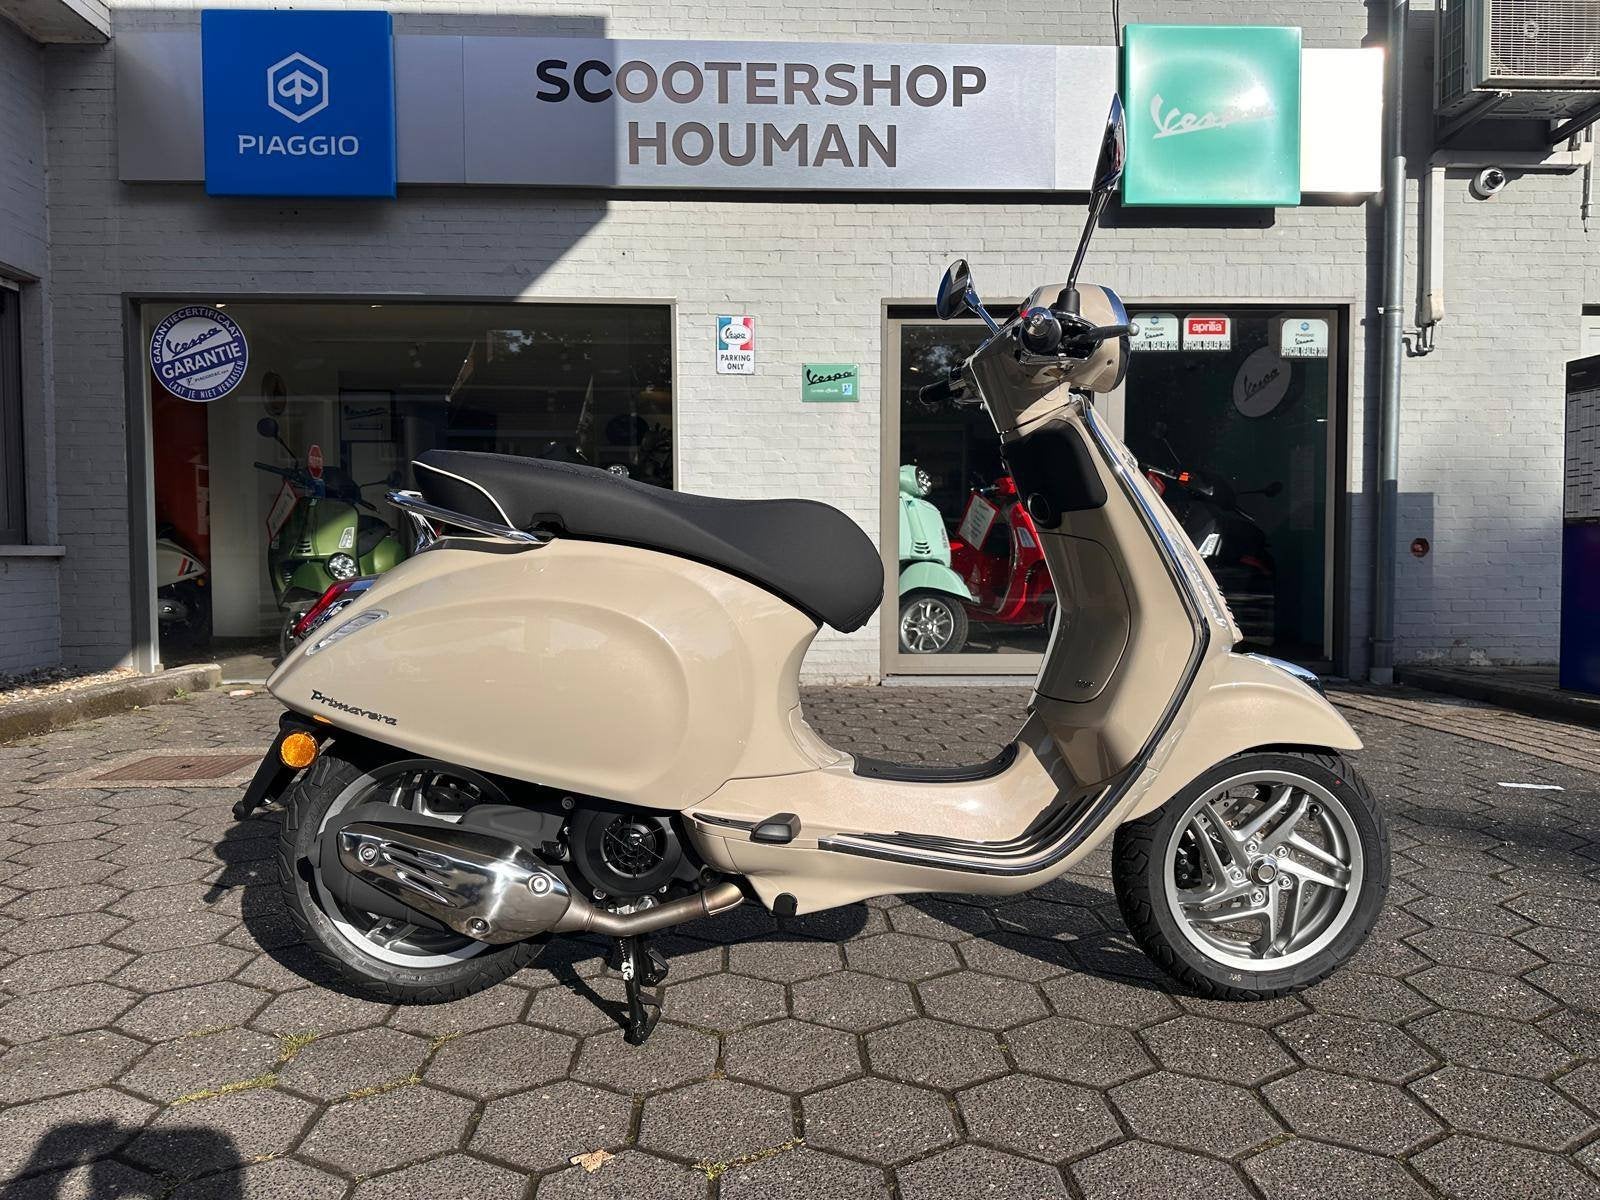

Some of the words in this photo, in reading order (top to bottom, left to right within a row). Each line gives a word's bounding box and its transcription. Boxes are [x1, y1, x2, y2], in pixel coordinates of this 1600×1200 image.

[535, 59, 987, 108] SCOOTERSHOP
[237, 134, 360, 156] PIAGGIO
[627, 121, 898, 168] HOUMAN
[152, 307, 241, 364] GARANTIECERTIFICAAT
[165, 327, 223, 358] Vespa
[725, 327, 747, 340] Vespa
[1192, 321, 1222, 334] aprilia
[162, 342, 242, 379] GARANTIE
[720, 354, 751, 362] PARKING
[727, 362, 745, 370] ONLY
[168, 381, 184, 395] LAAT
[188, 390, 196, 399] JE
[200, 388, 217, 399] NIET
[218, 360, 245, 393] VERRASSEN
[806, 368, 855, 386] Vespa
[310, 689, 398, 726] Primavera
